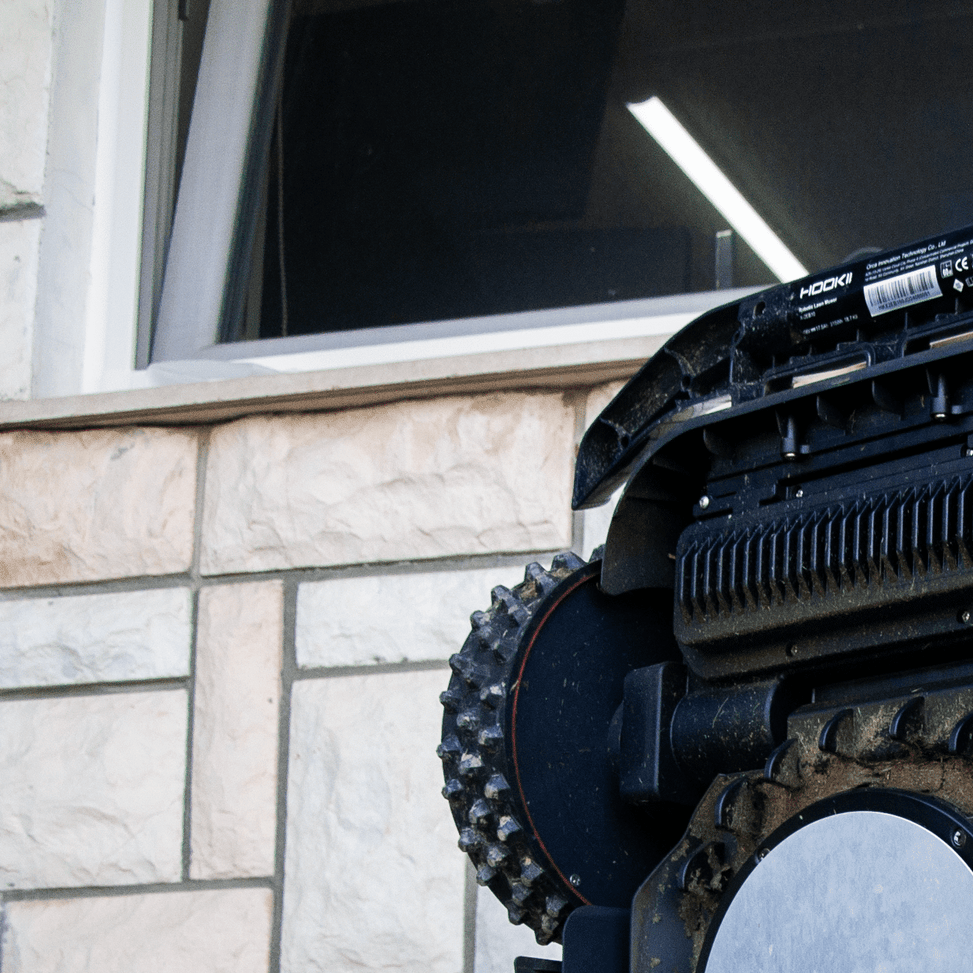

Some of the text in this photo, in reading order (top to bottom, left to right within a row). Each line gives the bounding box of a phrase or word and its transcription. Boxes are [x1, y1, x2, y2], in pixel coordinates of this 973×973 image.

[878, 255, 901, 267] Innovation
[901, 247, 928, 260] Technology
[955, 256, 969, 272] CE
[799, 271, 853, 299] HOOKII
